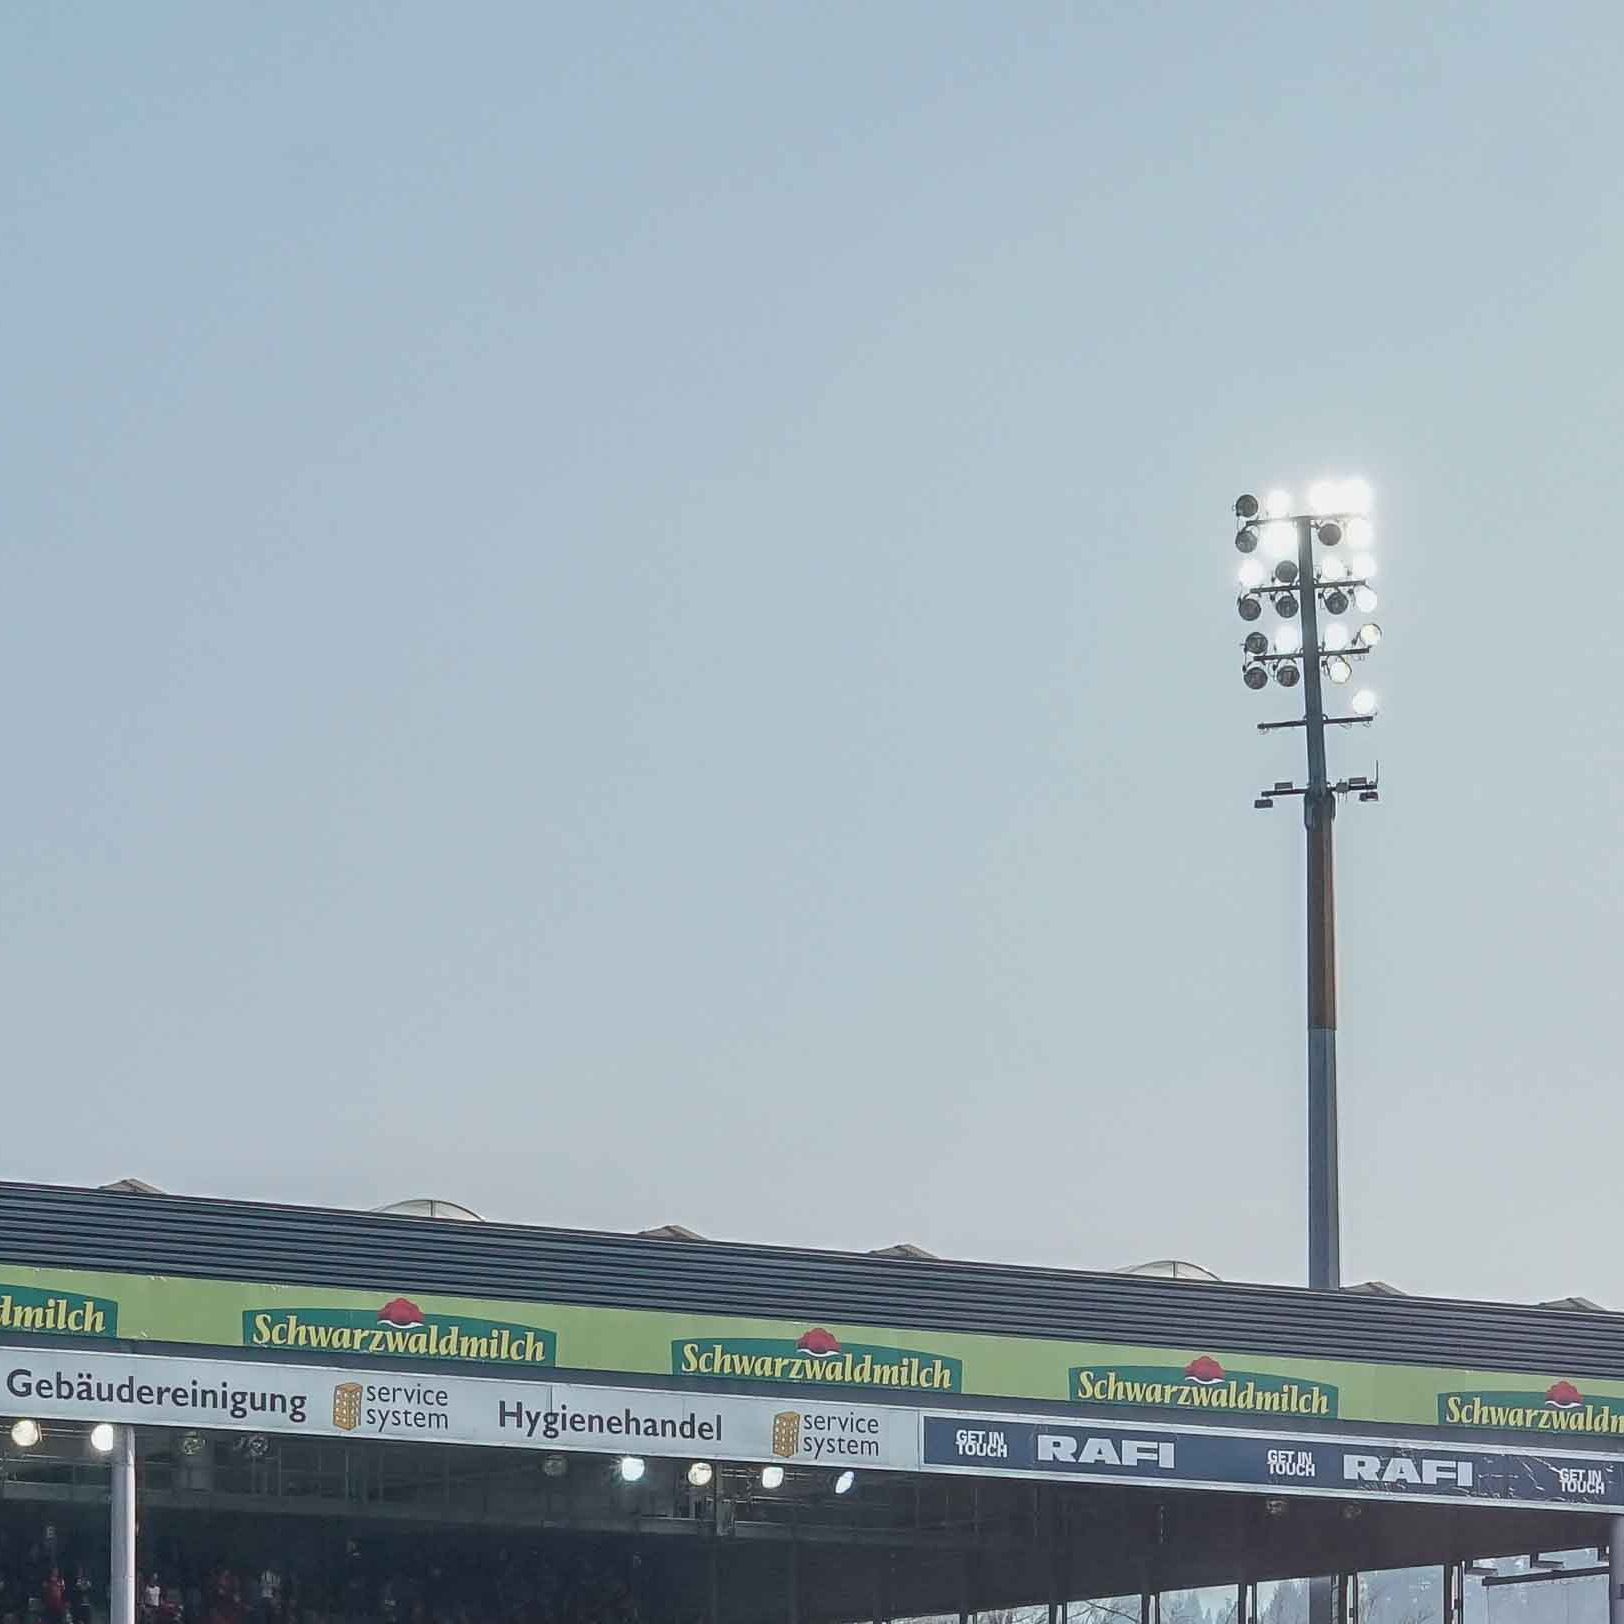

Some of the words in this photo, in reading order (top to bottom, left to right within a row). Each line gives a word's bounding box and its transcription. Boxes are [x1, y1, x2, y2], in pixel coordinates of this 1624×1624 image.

[253, 1314, 546, 1363] Schwarzwaldmilch
[682, 1343, 952, 1390] Schwarzwaldmilch
[6, 1367, 307, 1424] Gebäudereinigung
[366, 1382, 448, 1407] service
[1078, 1371, 1329, 1416] Schwarzwaldmilch
[366, 1404, 448, 1432] system
[498, 1401, 723, 1443] Hygienehandel
[803, 1412, 879, 1436] service
[803, 1434, 880, 1458] system
[956, 1430, 985, 1444] GET
[988, 1431, 1004, 1447] IN
[957, 1442, 1008, 1458] TOUCH
[1037, 1434, 1175, 1469] RAFI
[1268, 1450, 1294, 1464] GET
[1297, 1451, 1312, 1466] IN
[1269, 1462, 1315, 1477] TOUCH
[1343, 1454, 1473, 1487] RAFI
[1561, 1468, 1585, 1483] GET
[1587, 1470, 1602, 1484] IN
[1562, 1481, 1605, 1495] TOUCH
